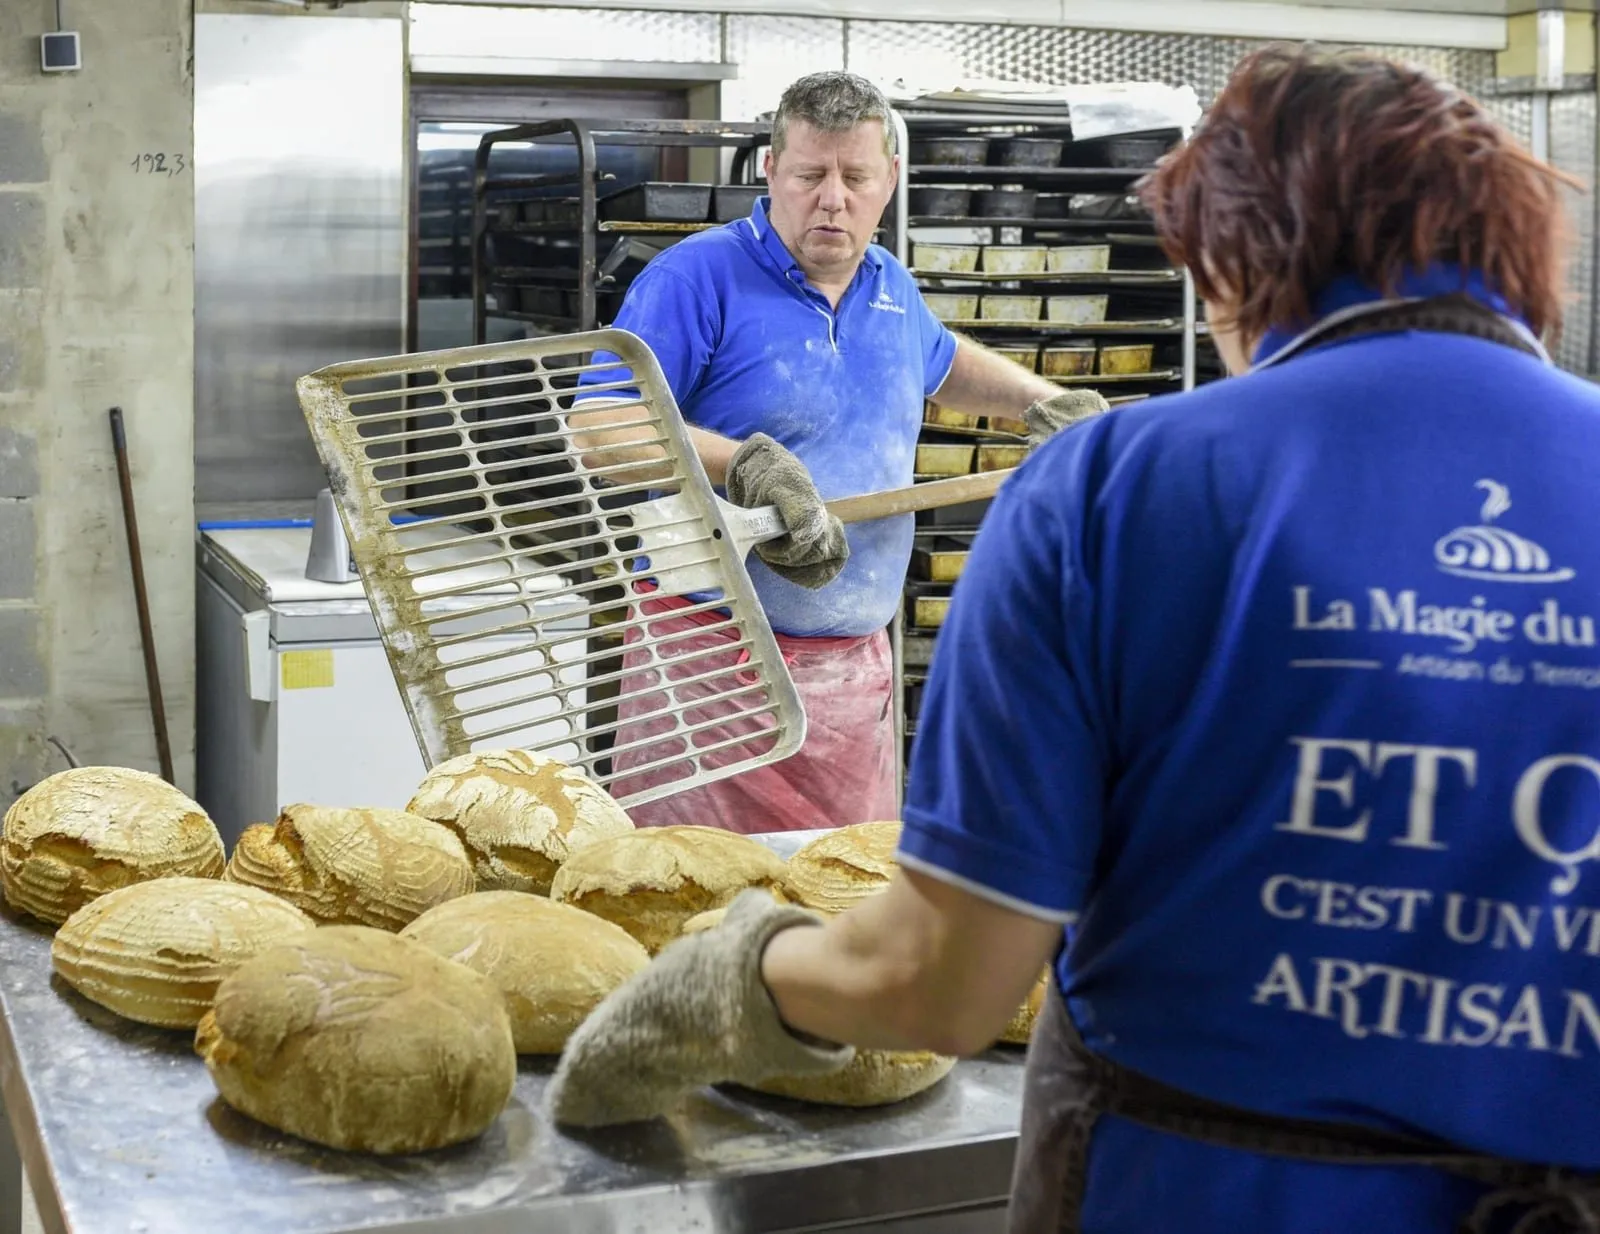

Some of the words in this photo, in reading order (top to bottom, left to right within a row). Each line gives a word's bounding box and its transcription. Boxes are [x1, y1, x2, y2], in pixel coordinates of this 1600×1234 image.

[131, 152, 185, 178] 192,3
[1292, 585, 1356, 630] La
[1368, 587, 1515, 653] Magie
[1523, 598, 1596, 647] du
[1489, 655, 1525, 685] du
[1273, 735, 1478, 850] ET
[1260, 873, 1434, 932] C'EST
[1443, 893, 1543, 949] UN
[1250, 952, 1600, 1058] ARTISAN
